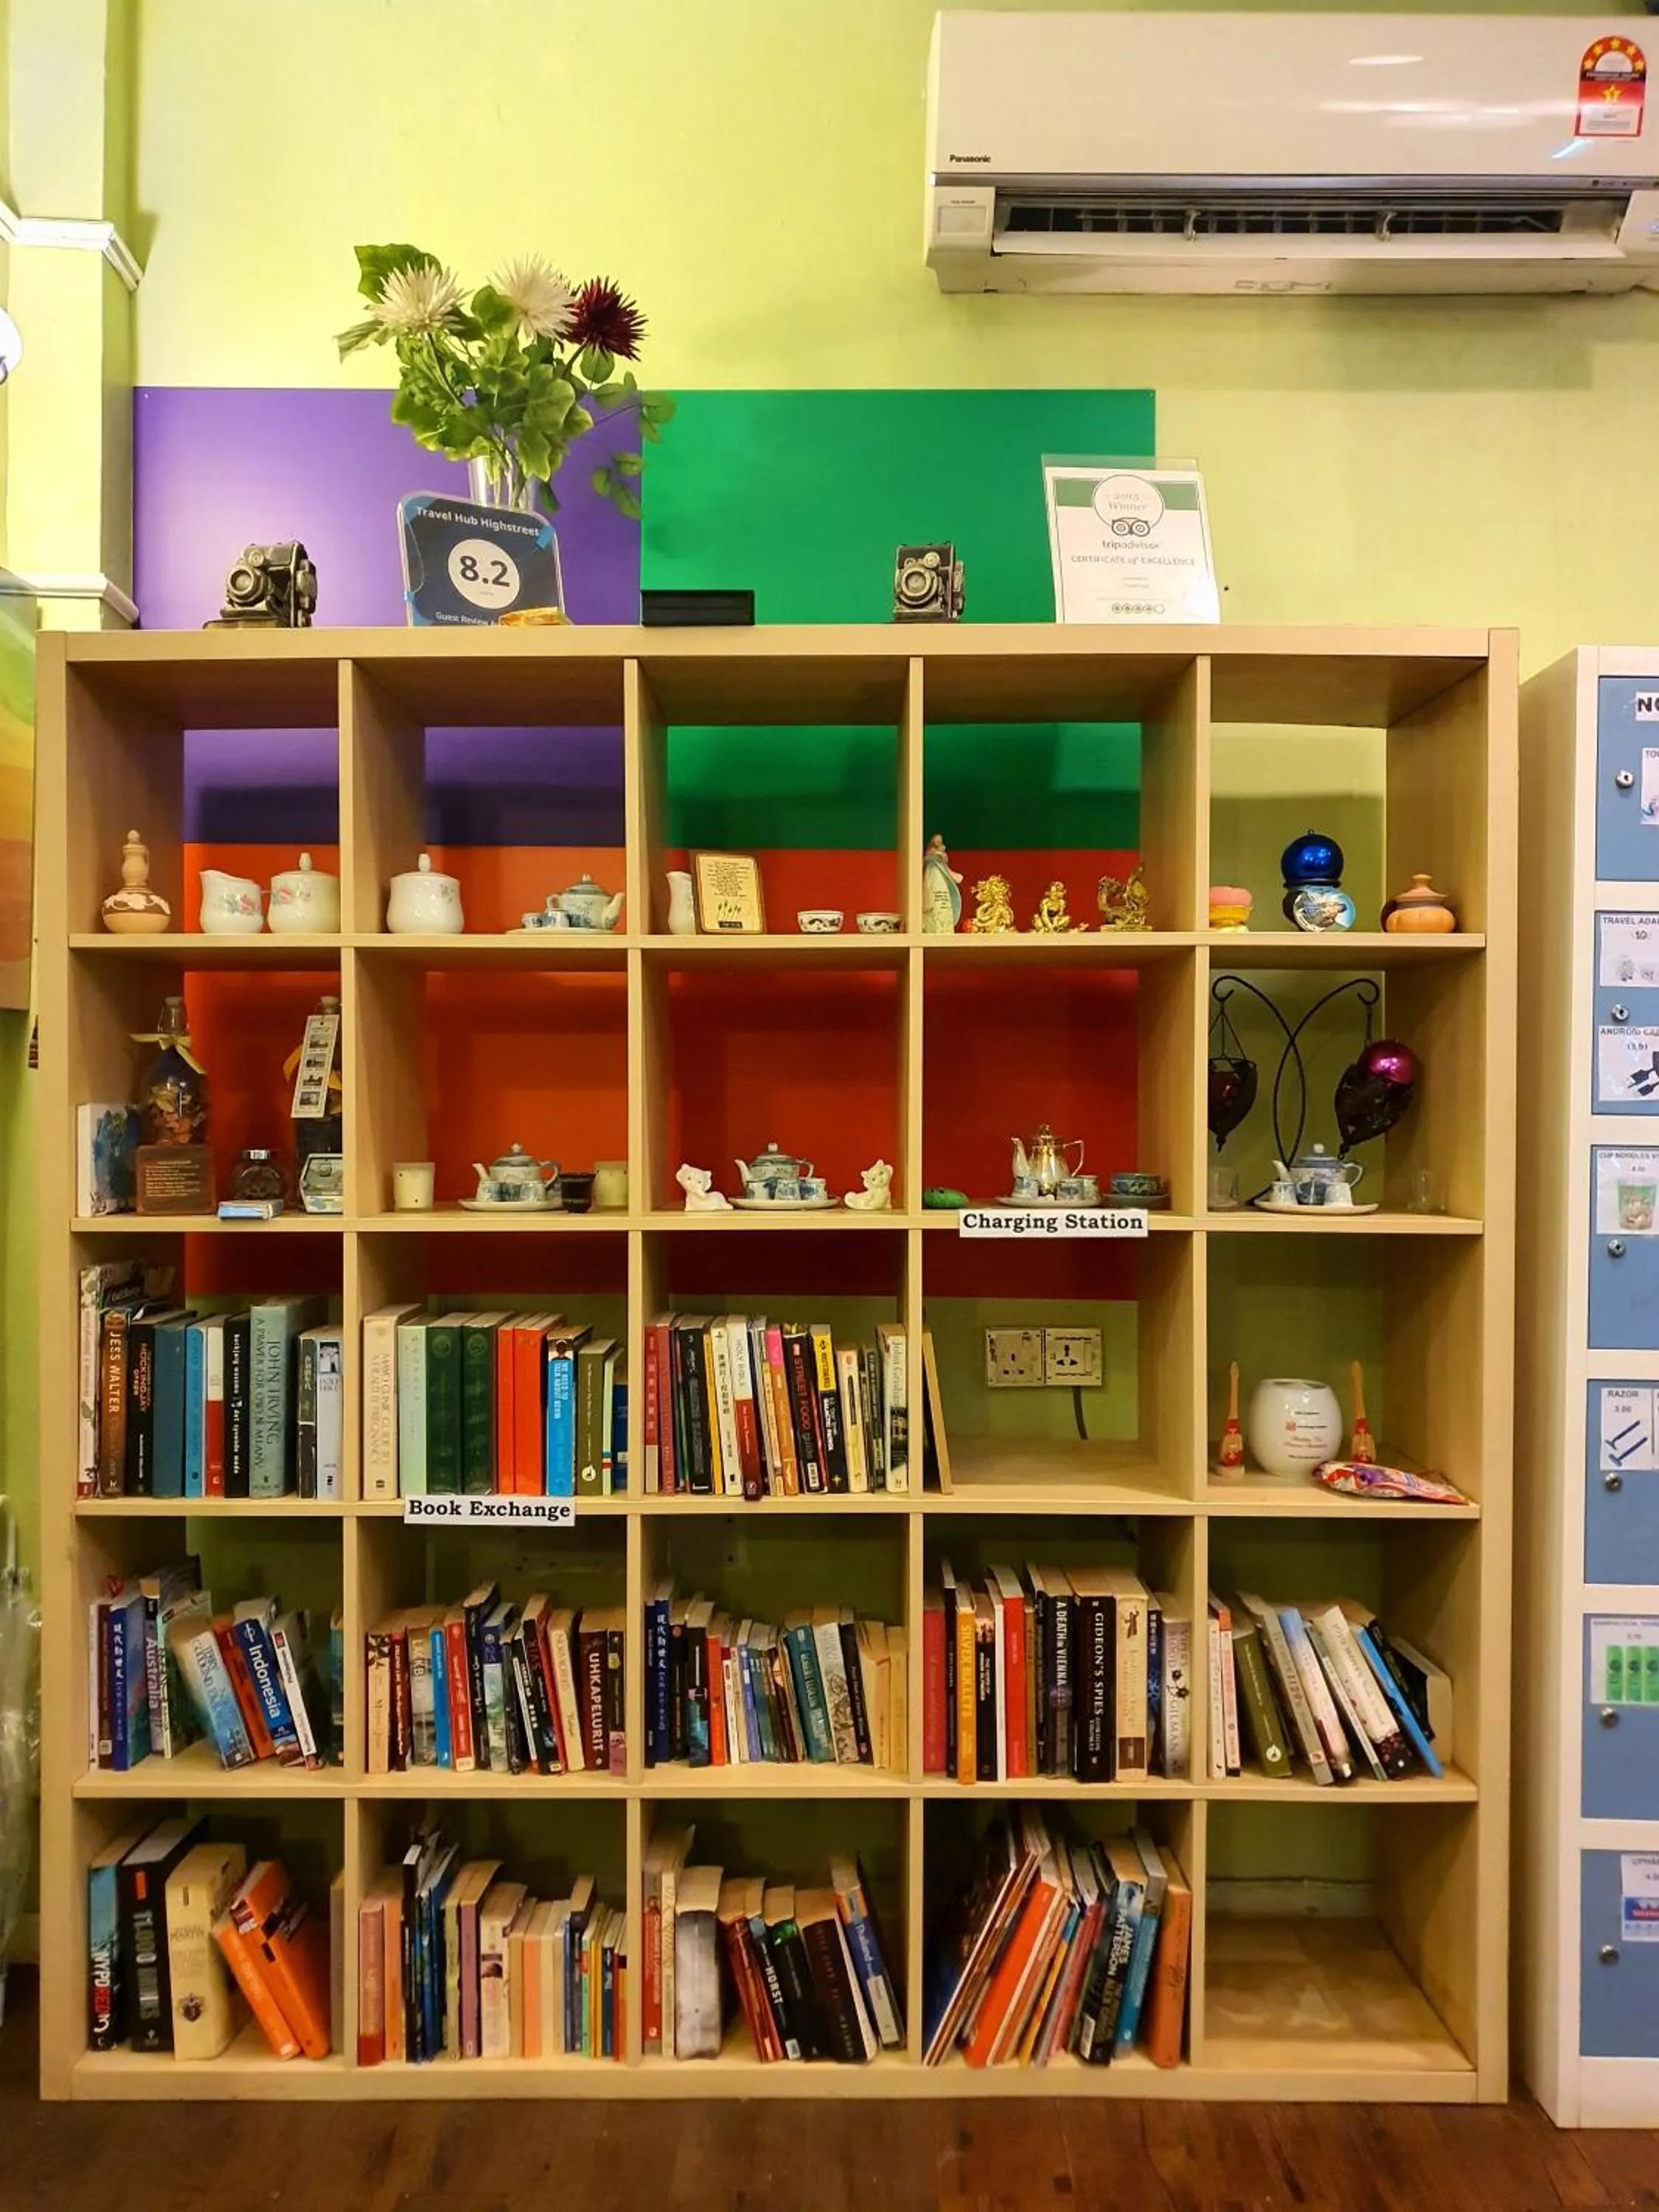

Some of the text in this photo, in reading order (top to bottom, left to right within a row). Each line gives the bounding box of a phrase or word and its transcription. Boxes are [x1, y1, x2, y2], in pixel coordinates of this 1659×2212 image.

[949, 154, 992, 163] Panasonic
[416, 507, 540, 537] Travel Hub Highstreet
[1108, 502, 1149, 511] Winner
[1071, 554, 1125, 565] CERTIFICATE
[1141, 557, 1195, 566] EXCELLENCE
[1102, 539, 1161, 550] tripadvisor
[459, 555, 510, 587] 8.2
[436, 611, 459, 622] Guest
[1604, 917, 1659, 925] TRAVEL ADA
[963, 1214, 1144, 1234] Charging Station
[108, 1332, 122, 1413] JESS WALTER
[794, 1357, 807, 1397] STREET
[265, 1340, 281, 1444] JOHN IRVING
[1607, 1390, 1638, 1398] RAZOR
[409, 1500, 571, 1521] Book Exchange
[1056, 1610, 1068, 1639] DEATH
[960, 1624, 973, 1664] SILVER
[145, 1637, 159, 1709] Australia
[248, 1644, 281, 1719] Indonesia
[1056, 1649, 1068, 1686] VIENNA
[1093, 1613, 1105, 1716] GIDEON'S SPIES
[589, 1652, 604, 1753] UHKAPELURIT
[1107, 1907, 1127, 1977] PATTERSON
[1118, 1923, 1133, 1964] JAMES
[92, 1950, 110, 1987] NYPD
[764, 1964, 784, 2005] HORST
[94, 1987, 111, 2013] RED
